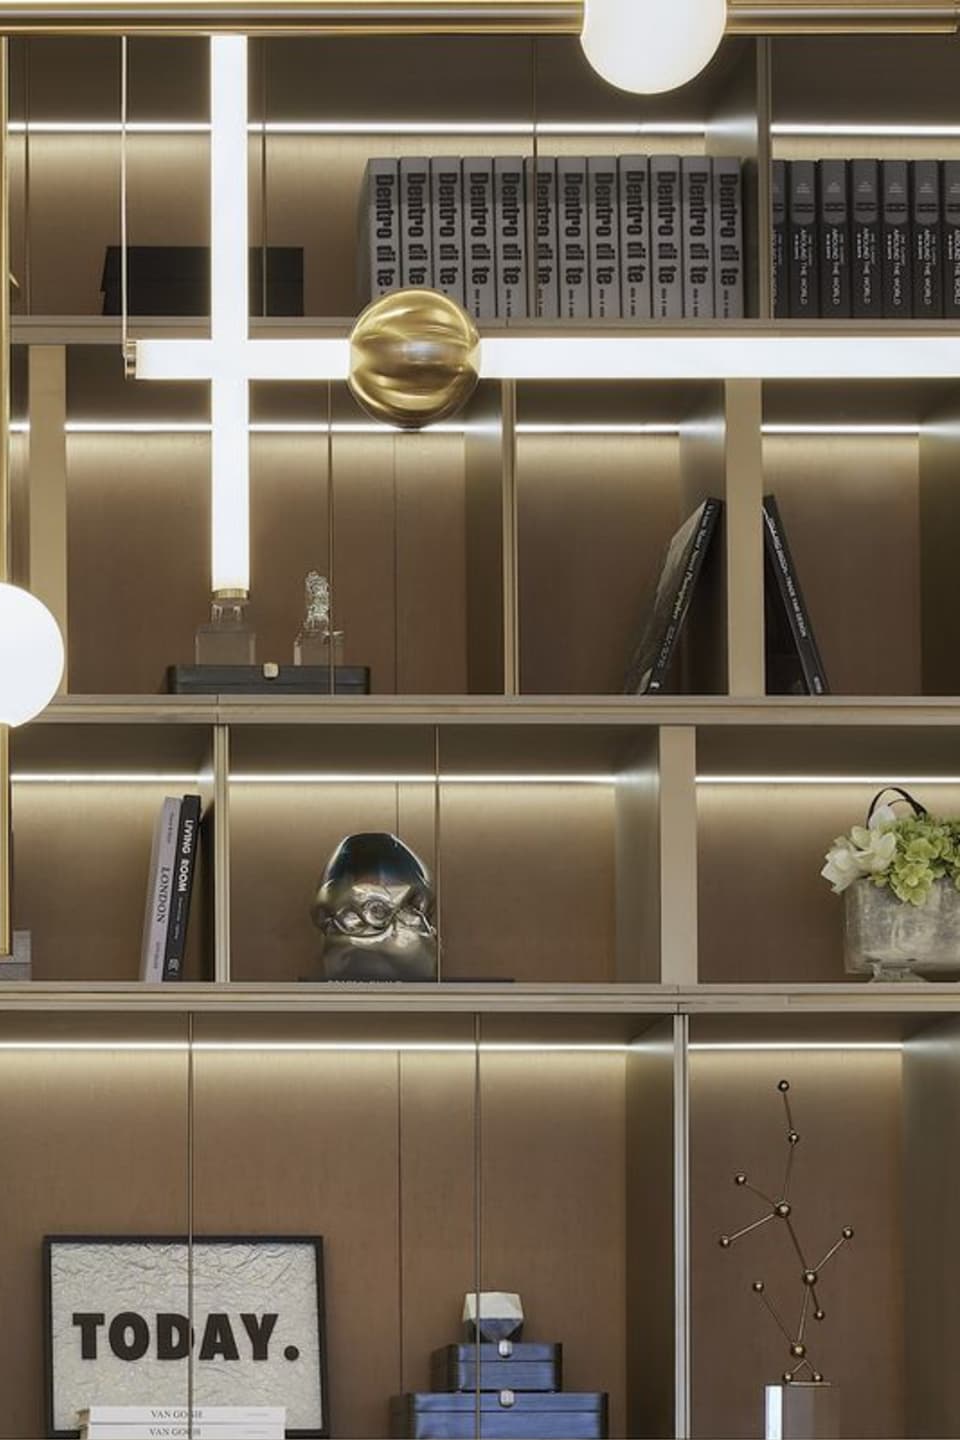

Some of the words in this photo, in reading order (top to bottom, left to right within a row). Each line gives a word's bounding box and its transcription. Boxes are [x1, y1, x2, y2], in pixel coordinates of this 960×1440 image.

[376, 174, 395, 239] Dentro
[407, 173, 426, 237] Dentro
[439, 173, 458, 237] Dentro
[470, 173, 489, 237] Dentro
[501, 173, 520, 237] Dentro
[564, 173, 583, 237] Dentro
[594, 172, 614, 237] Dentro
[626, 171, 645, 235] Dentro
[657, 171, 677, 236] Dentro
[688, 172, 707, 237] Dentro
[719, 173, 738, 238] Dentro
[377, 246, 396, 262] di
[408, 244, 427, 260] di
[439, 244, 459, 260] di
[471, 244, 490, 260] di
[503, 244, 522, 260] di
[565, 244, 585, 260] di
[596, 243, 615, 260] di
[627, 241, 646, 259] di
[658, 242, 678, 260] di
[690, 242, 709, 260] di
[720, 244, 740, 262] di
[377, 269, 396, 286] te
[408, 267, 427, 285] te
[439, 267, 458, 285] te
[471, 267, 490, 285] te
[503, 266, 521, 285] te
[565, 266, 584, 285] te
[596, 266, 615, 285] te
[627, 264, 646, 283] te
[658, 265, 677, 284] te
[690, 265, 709, 284] te
[720, 267, 739, 286] te
[182, 820, 194, 853] LIVING
[178, 859, 189, 892] ROOM
[156, 867, 171, 923] LONDON
[72, 1311, 300, 1362] TODAY.
[151, 1410, 170, 1418] VAN
[172, 1410, 202, 1418] GOH
[149, 1428, 169, 1436] VAN
